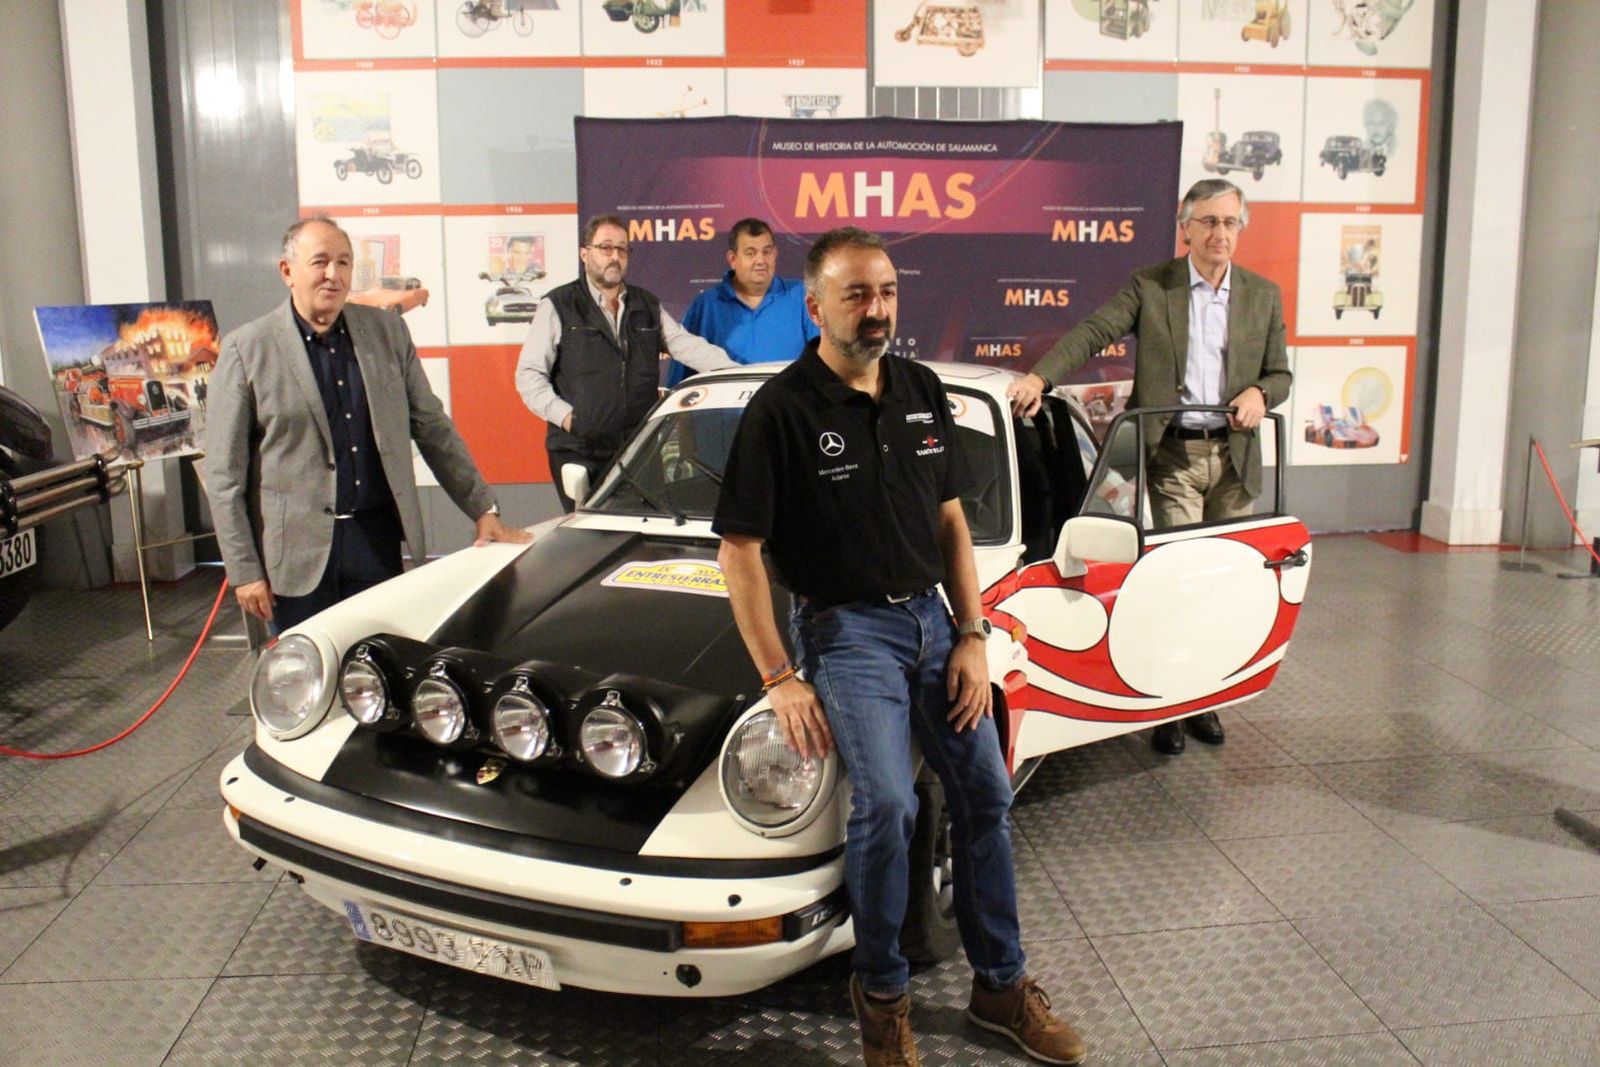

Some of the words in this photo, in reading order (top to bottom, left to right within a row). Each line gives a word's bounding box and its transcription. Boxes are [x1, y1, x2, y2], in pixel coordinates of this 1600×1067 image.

[772, 142, 802, 152] MUSEO
[803, 142, 814, 152] DE
[816, 142, 852, 152] HISTORIA
[853, 141, 864, 151] DE
[866, 141, 876, 150] LA
[877, 140, 934, 152] AUTOMOCIÓN
[936, 142, 946, 153] DE
[947, 142, 998, 153] SALAMANCA
[794, 171, 977, 220] MHAS
[628, 216, 716, 242] MHAS
[1051, 219, 1135, 243] MHAS
[1004, 287, 1070, 307] MHAS
[975, 343, 1023, 358] MHAS
